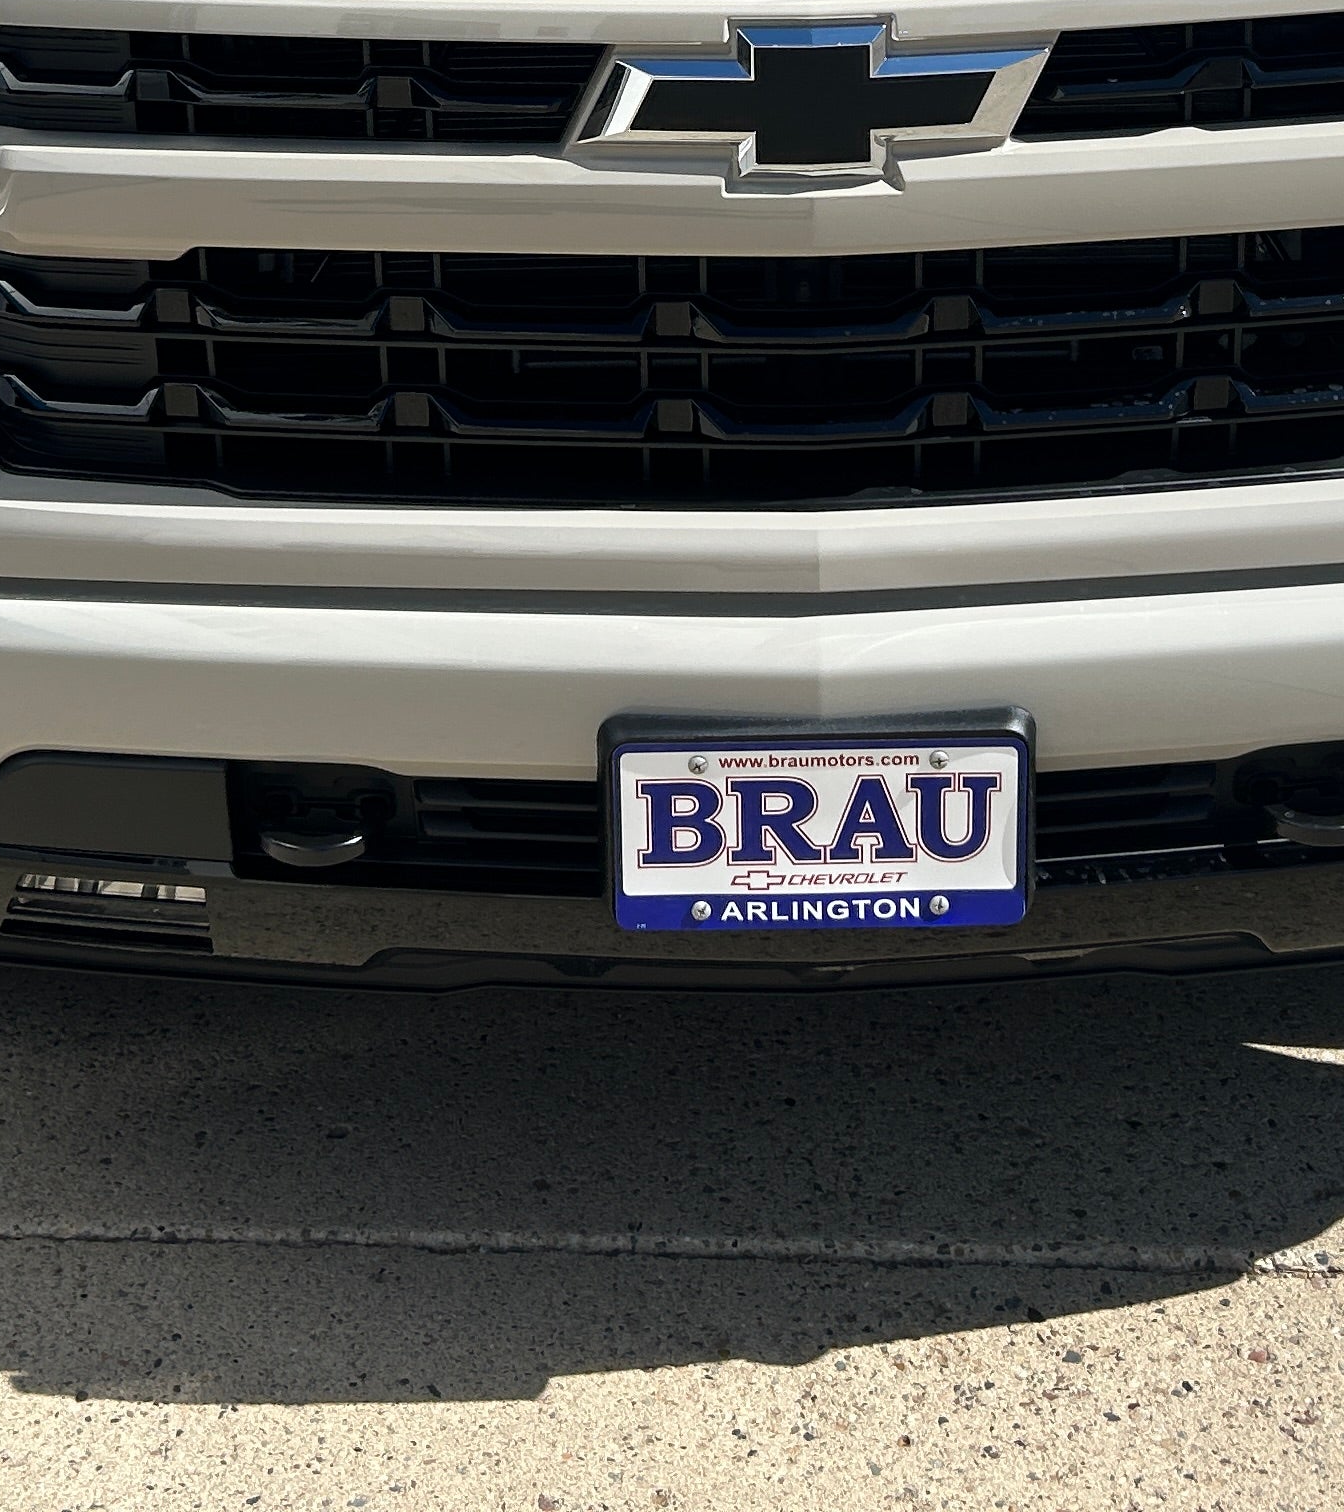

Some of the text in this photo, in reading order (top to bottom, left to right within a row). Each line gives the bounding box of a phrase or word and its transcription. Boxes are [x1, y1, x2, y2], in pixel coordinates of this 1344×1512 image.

[719, 753, 920, 768] www.braumotors.com
[635, 772, 1003, 869] BRAU
[787, 871, 909, 886] CHEVROLET
[721, 897, 921, 921] ARLINGTON
